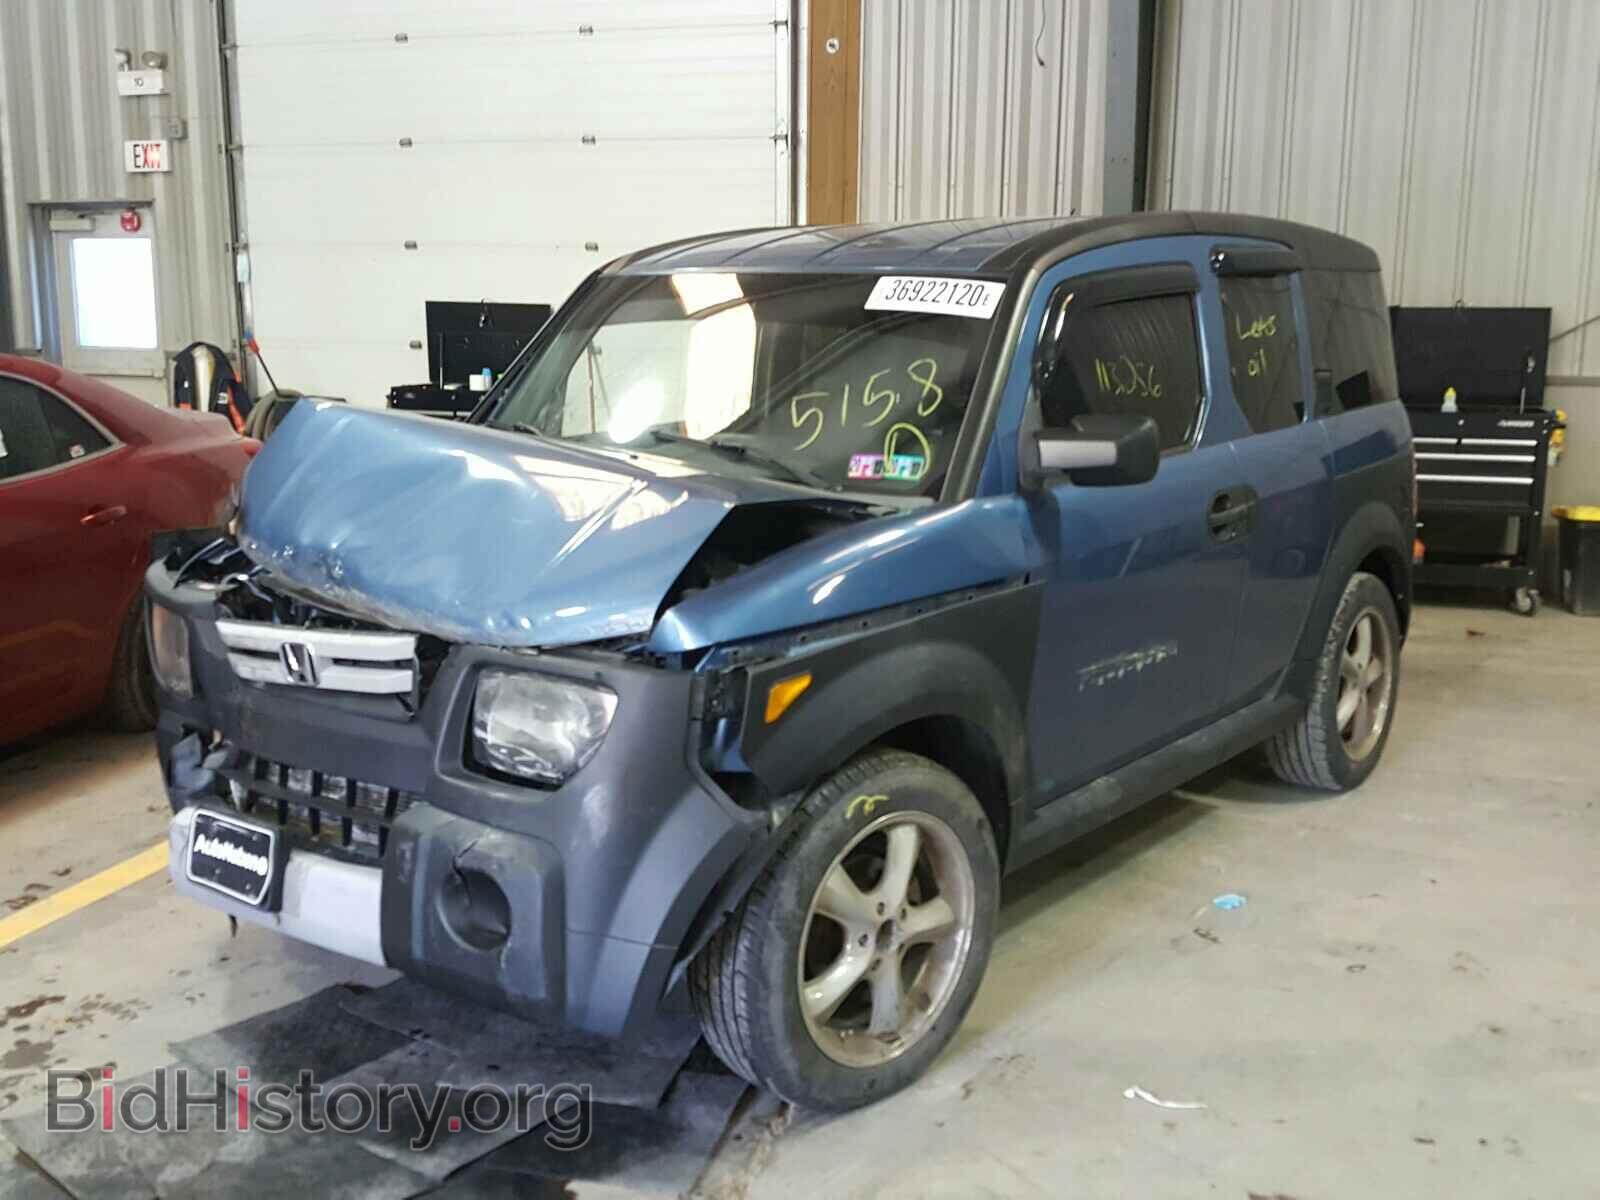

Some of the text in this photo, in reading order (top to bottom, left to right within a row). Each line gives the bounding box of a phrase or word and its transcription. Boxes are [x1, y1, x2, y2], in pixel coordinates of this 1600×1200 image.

[133, 143, 161, 168] EXIT
[885, 279, 985, 307] 36922120
[790, 357, 943, 450] 5158
